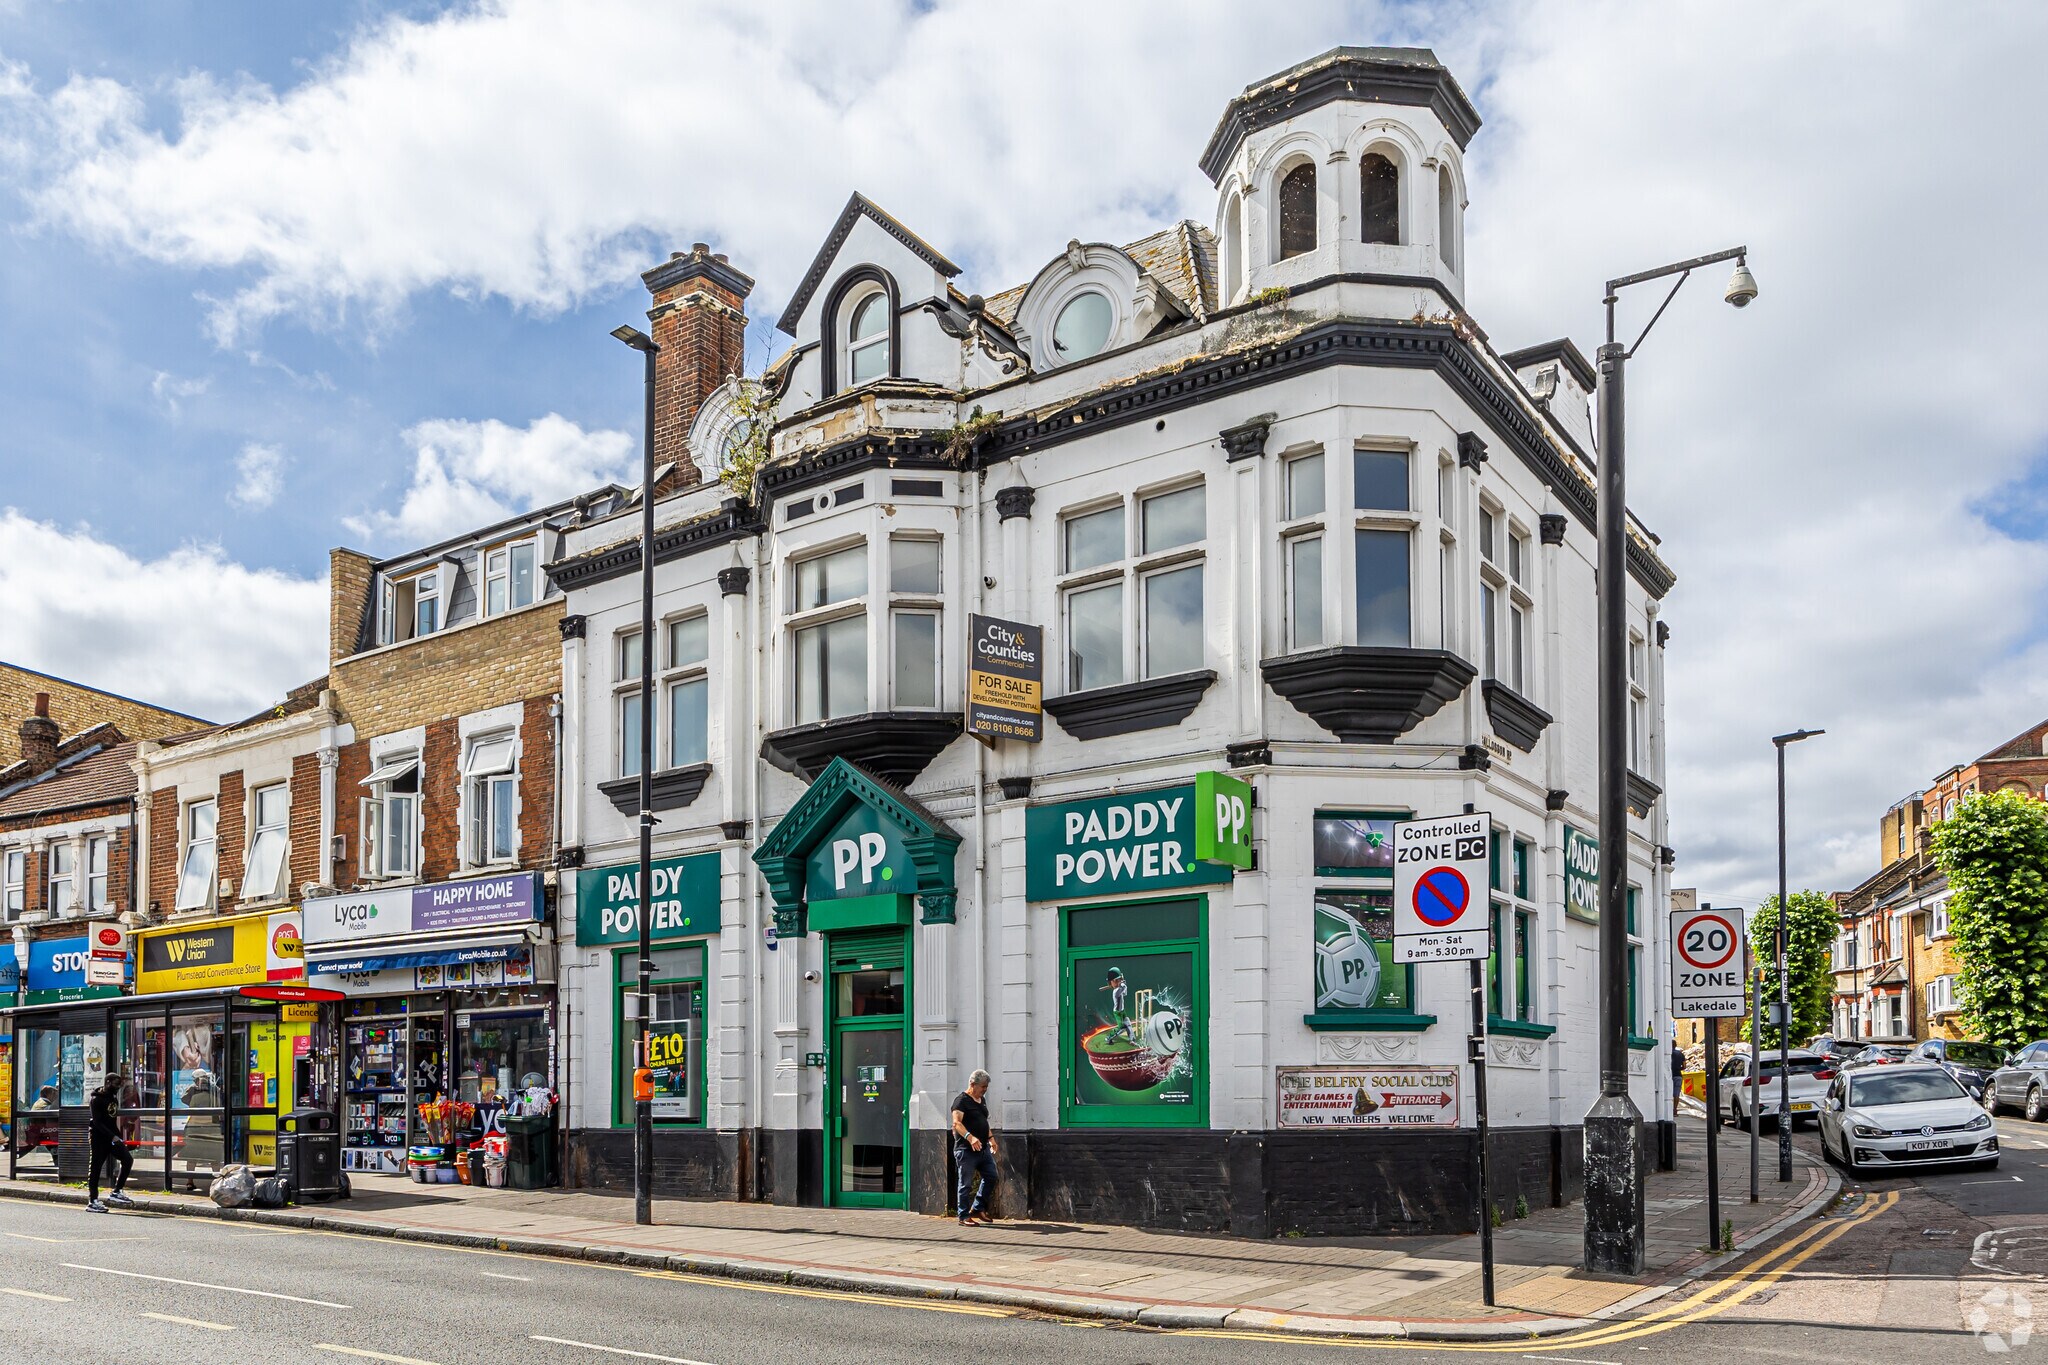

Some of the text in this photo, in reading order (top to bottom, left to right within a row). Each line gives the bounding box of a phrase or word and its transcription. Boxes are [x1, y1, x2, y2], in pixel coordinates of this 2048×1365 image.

[977, 638, 1035, 662] Counties
[986, 655, 1025, 669] Commercial
[978, 674, 1032, 695] FOR SALE
[972, 693, 1039, 711] DEVELOPMENT POTENTIAL
[984, 689, 1026, 702] FREEHOLD WITH
[975, 711, 1035, 727] cityandcounties.com
[975, 720, 1034, 738] 020 8106 8666
[1065, 797, 1184, 846] PADDY
[1403, 819, 1481, 841] Controlled
[1398, 839, 1485, 864] ZONE PC
[1571, 838, 1599, 876] PADD
[433, 880, 514, 906] HAPPY HOME
[1569, 873, 1599, 913] POWE
[335, 904, 368, 926] Lyca
[349, 923, 368, 931] Mobile
[278, 930, 295, 939] POST
[1419, 937, 1439, 947] Mon
[1446, 935, 1463, 945] Sat
[1686, 929, 1728, 952] 20
[186, 937, 215, 948] Western
[186, 949, 207, 961] Union
[458, 949, 508, 962] LycaMobile.co.uk
[1407, 949, 1413, 958] 9
[1435, 947, 1458, 957] 5.30
[1459, 947, 1474, 957] pm
[177, 963, 261, 981] Plumstead Convenience Store
[337, 964, 349, 972] your
[348, 961, 363, 970] world
[353, 980, 370, 988] Mobile
[1680, 972, 1737, 987] ZONE
[59, 993, 84, 1001] Groceries
[288, 1007, 318, 1017] Licence
[1681, 1001, 1737, 1012] Lakedale
[1163, 1018, 1183, 1039] PP
[649, 1033, 684, 1062] £10
[650, 1060, 666, 1068] ONLINE
[676, 1056, 685, 1064] BET
[1281, 1074, 1456, 1089] THE BELFRY SOCIAL CLUB
[1283, 1092, 1354, 1102] SPORT GAMES &
[1389, 1095, 1442, 1105] ENTRANCE
[1283, 1101, 1353, 1110] ENTERTAINMENT
[1302, 1114, 1436, 1124] NEW MEMBERS WELCOME
[384, 1133, 398, 1143] Lyca
